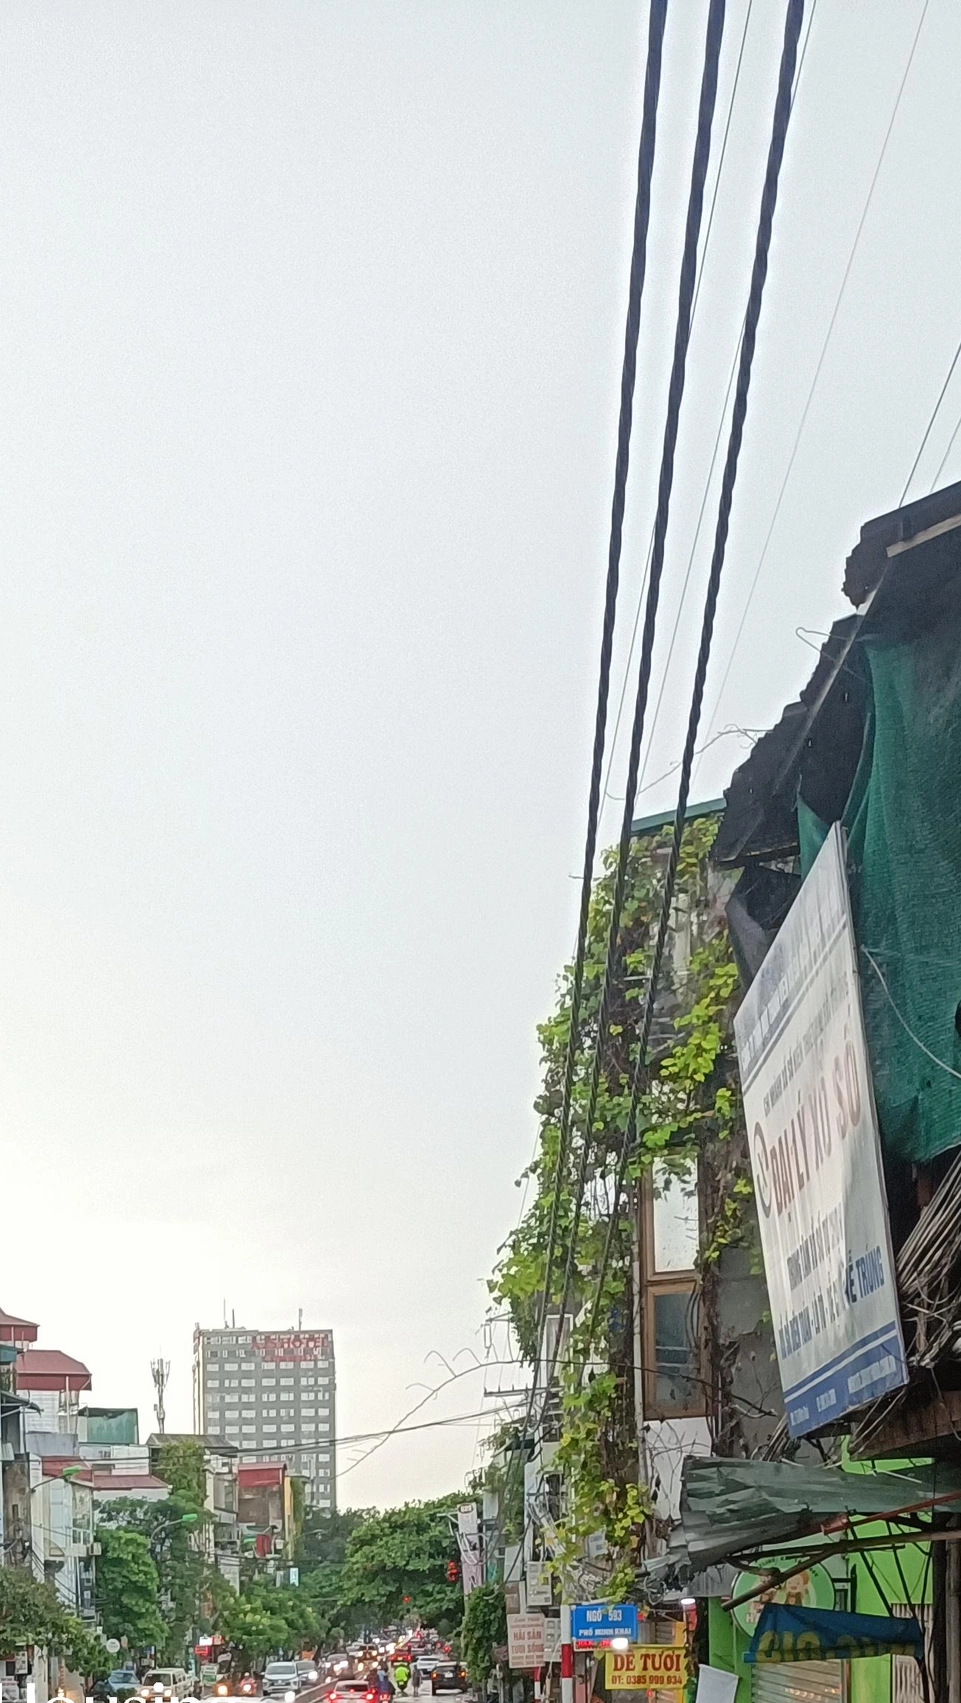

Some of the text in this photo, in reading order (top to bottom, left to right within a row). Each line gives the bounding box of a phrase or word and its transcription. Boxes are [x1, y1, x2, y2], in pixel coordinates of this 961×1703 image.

[854, 1241, 885, 1300] TRÚNG
[608, 1609, 623, 1621] 593
[613, 1649, 681, 1671] DÊ TƯƠI
